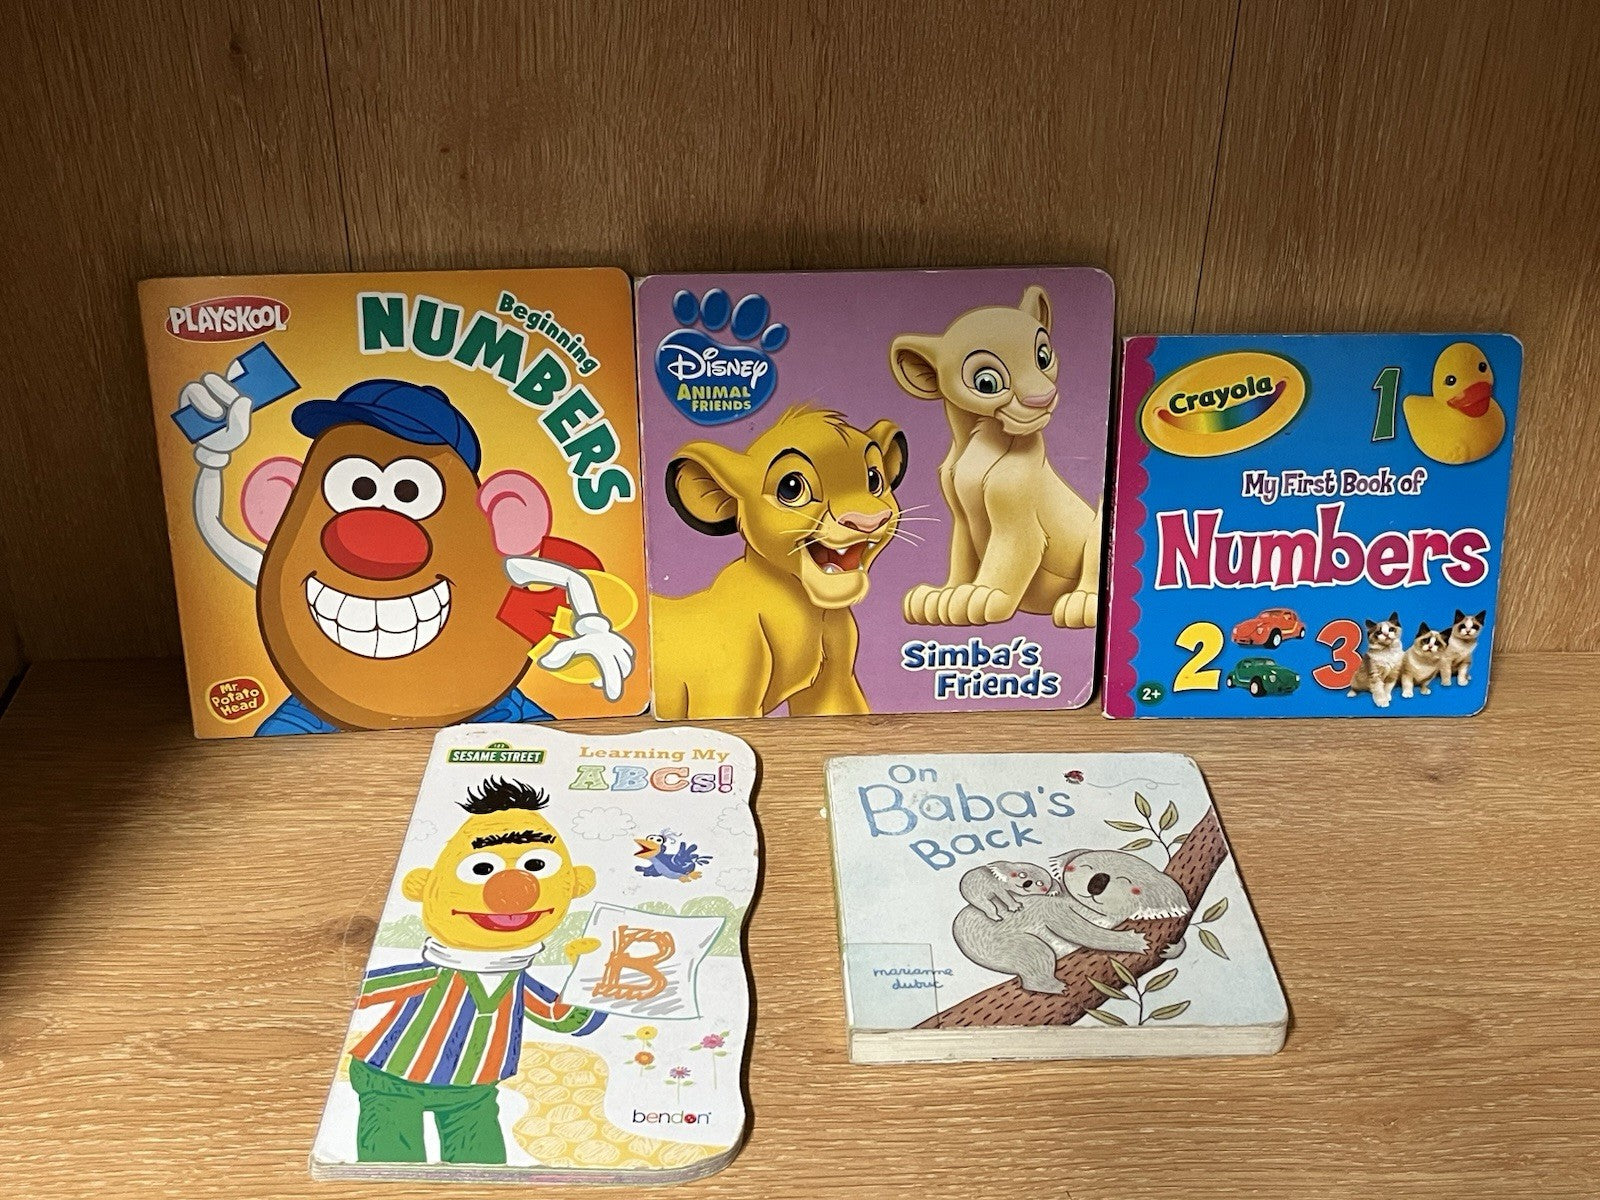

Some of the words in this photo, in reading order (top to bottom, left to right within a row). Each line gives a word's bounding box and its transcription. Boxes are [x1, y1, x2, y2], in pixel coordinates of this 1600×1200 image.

[169, 305, 287, 334] PLAYSKOOL
[500, 292, 597, 375] Beginning
[360, 295, 633, 511] NUMBERS
[677, 383, 751, 400] ANIMAL
[691, 400, 752, 412] FRIENDS
[1168, 376, 1274, 414] Crayola
[1372, 367, 1400, 442] 1
[1244, 472, 1277, 501] My
[1282, 470, 1337, 496] First
[1342, 468, 1393, 495] Book
[1399, 469, 1426, 495] of
[1157, 503, 1490, 589] Numbers
[903, 638, 1039, 669] Simba's
[1173, 621, 1224, 692] 2
[1312, 620, 1362, 690] 3
[211, 688, 260, 707] Potato
[936, 669, 1059, 698] Friends
[1142, 688, 1161, 700] 2+
[220, 698, 258, 716] Head
[453, 751, 497, 762] SESAME
[500, 752, 541, 763] STREET
[579, 746, 685, 762] Learning
[692, 749, 730, 763] My
[569, 765, 733, 793] ABCs!
[888, 764, 938, 784] On
[858, 783, 1075, 836] Baba's
[910, 821, 1042, 870] Back
[592, 925, 675, 1000] B
[632, 1109, 710, 1124] bendon
